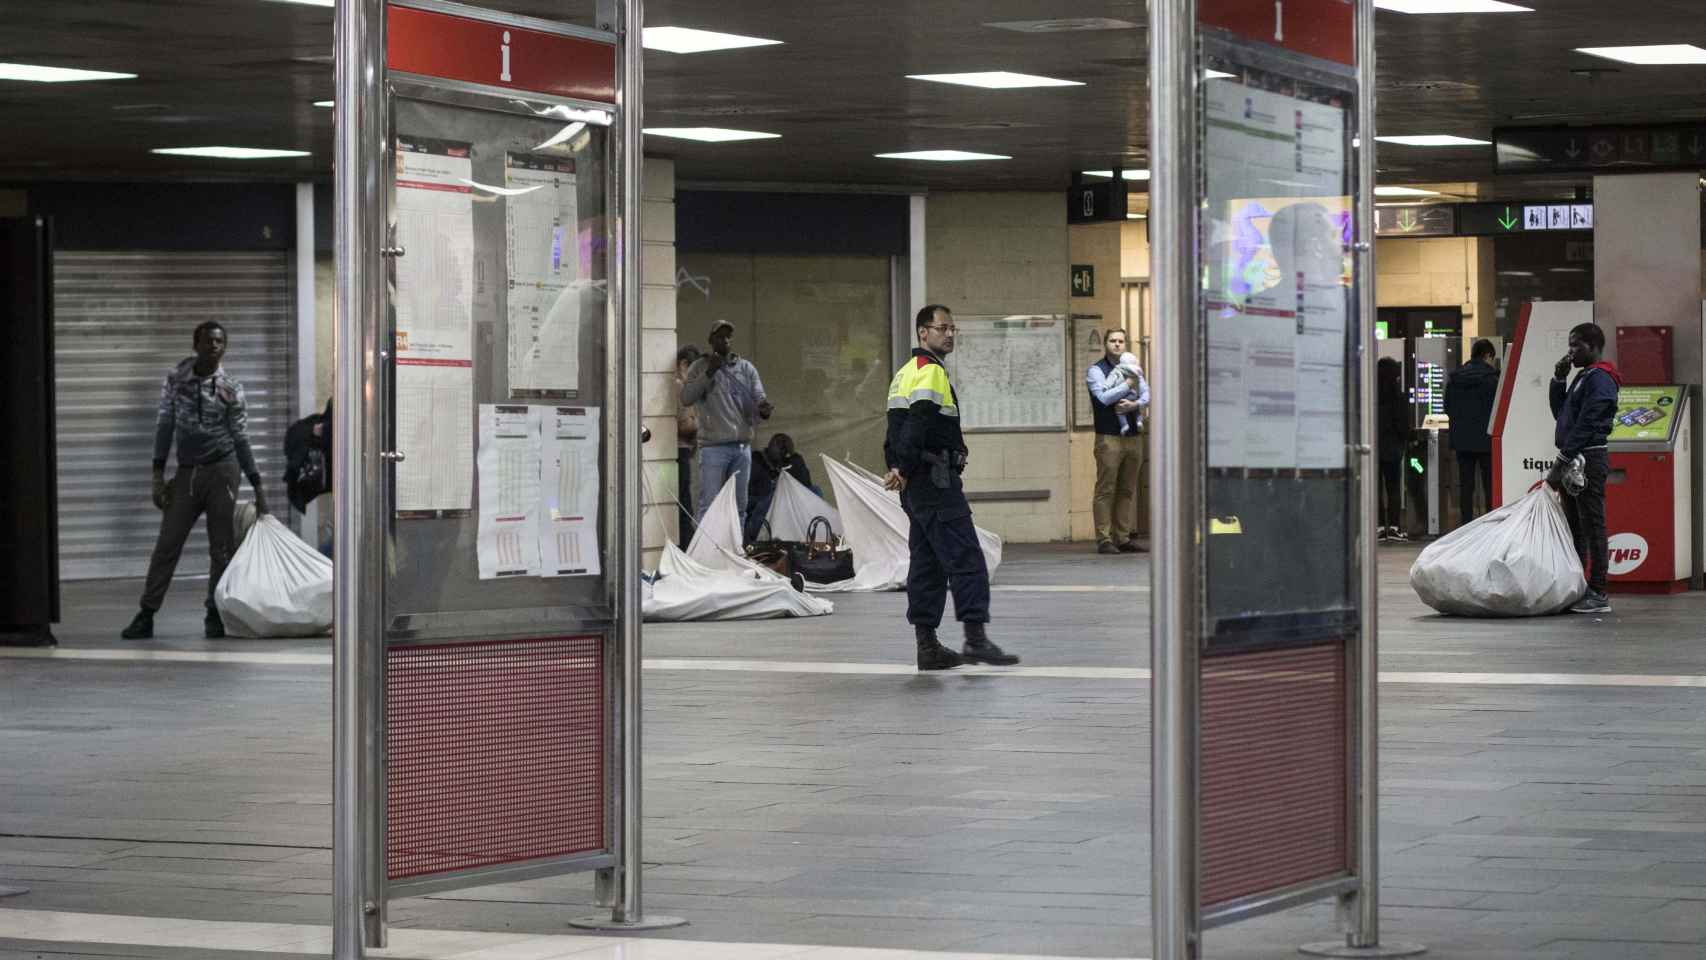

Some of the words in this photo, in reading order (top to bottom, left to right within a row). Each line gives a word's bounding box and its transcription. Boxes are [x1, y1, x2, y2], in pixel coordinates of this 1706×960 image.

[501, 31, 511, 82] i
[1523, 457, 1554, 473] tiqu
[1608, 548, 1641, 563] TMB
